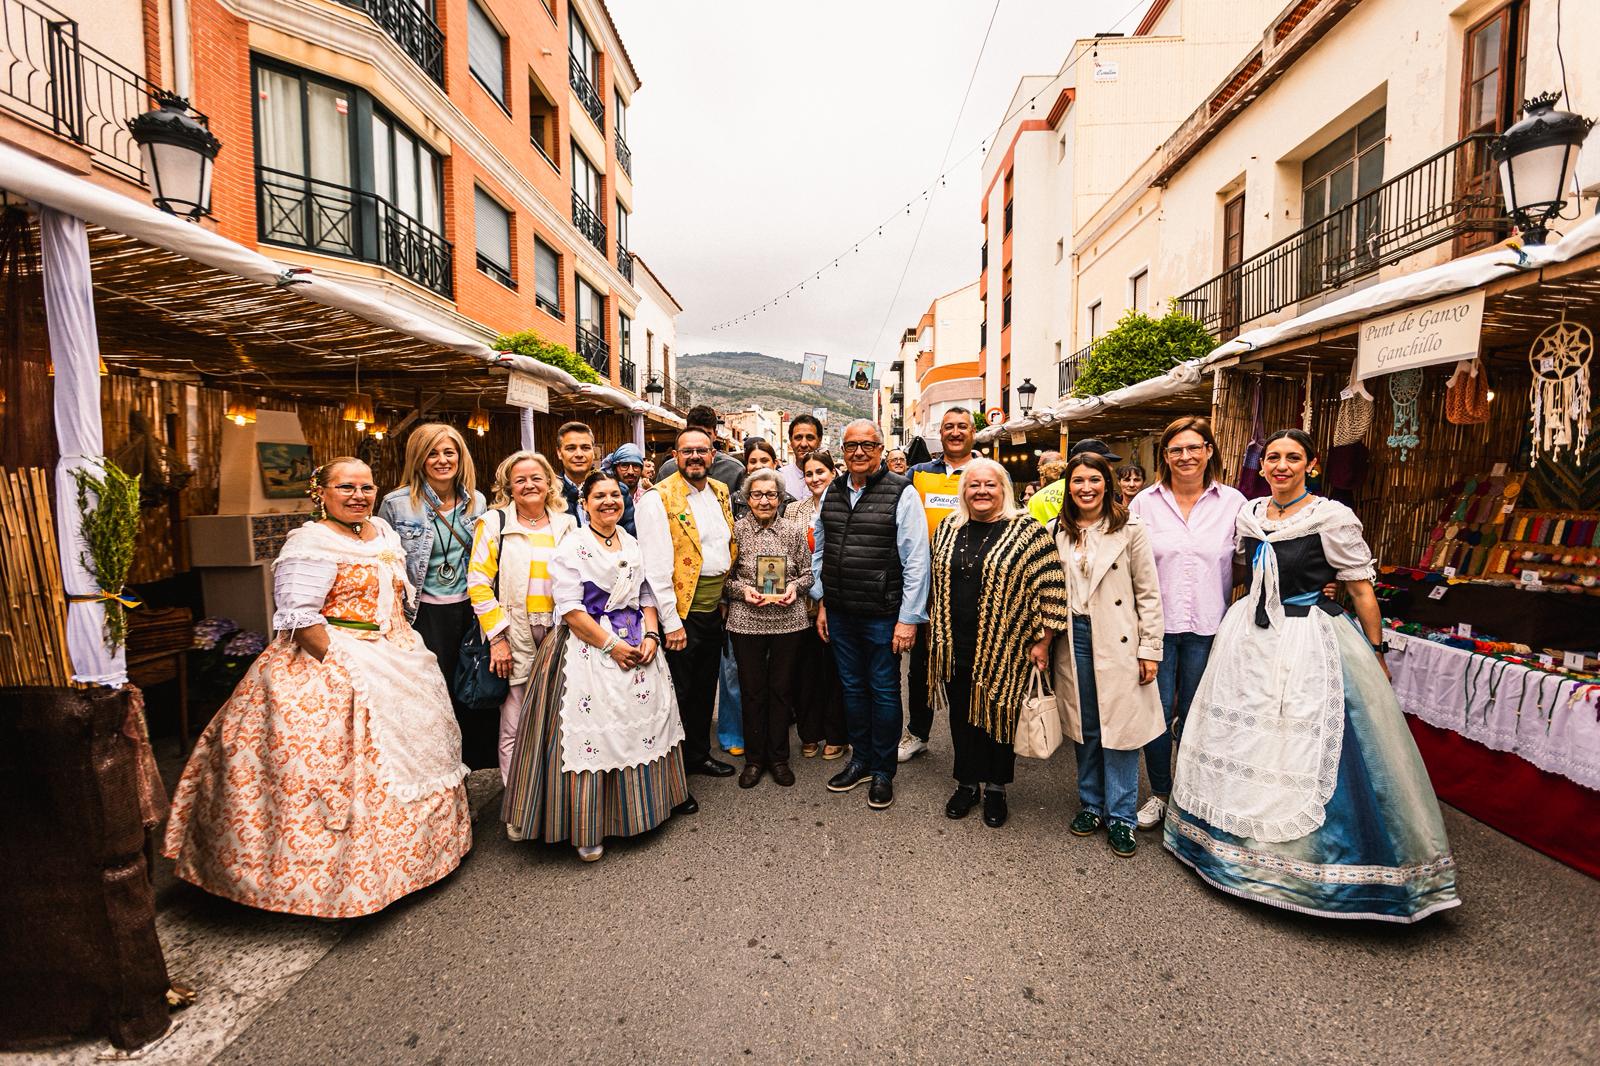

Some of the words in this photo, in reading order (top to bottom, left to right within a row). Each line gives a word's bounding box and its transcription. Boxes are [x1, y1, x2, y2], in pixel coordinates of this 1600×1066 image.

[1365, 321, 1395, 341] Punt
[1398, 312, 1414, 333] de
[1418, 304, 1470, 333] Ganxo
[1377, 332, 1442, 368] Ganchillo
[1044, 496, 1063, 504] LOC
